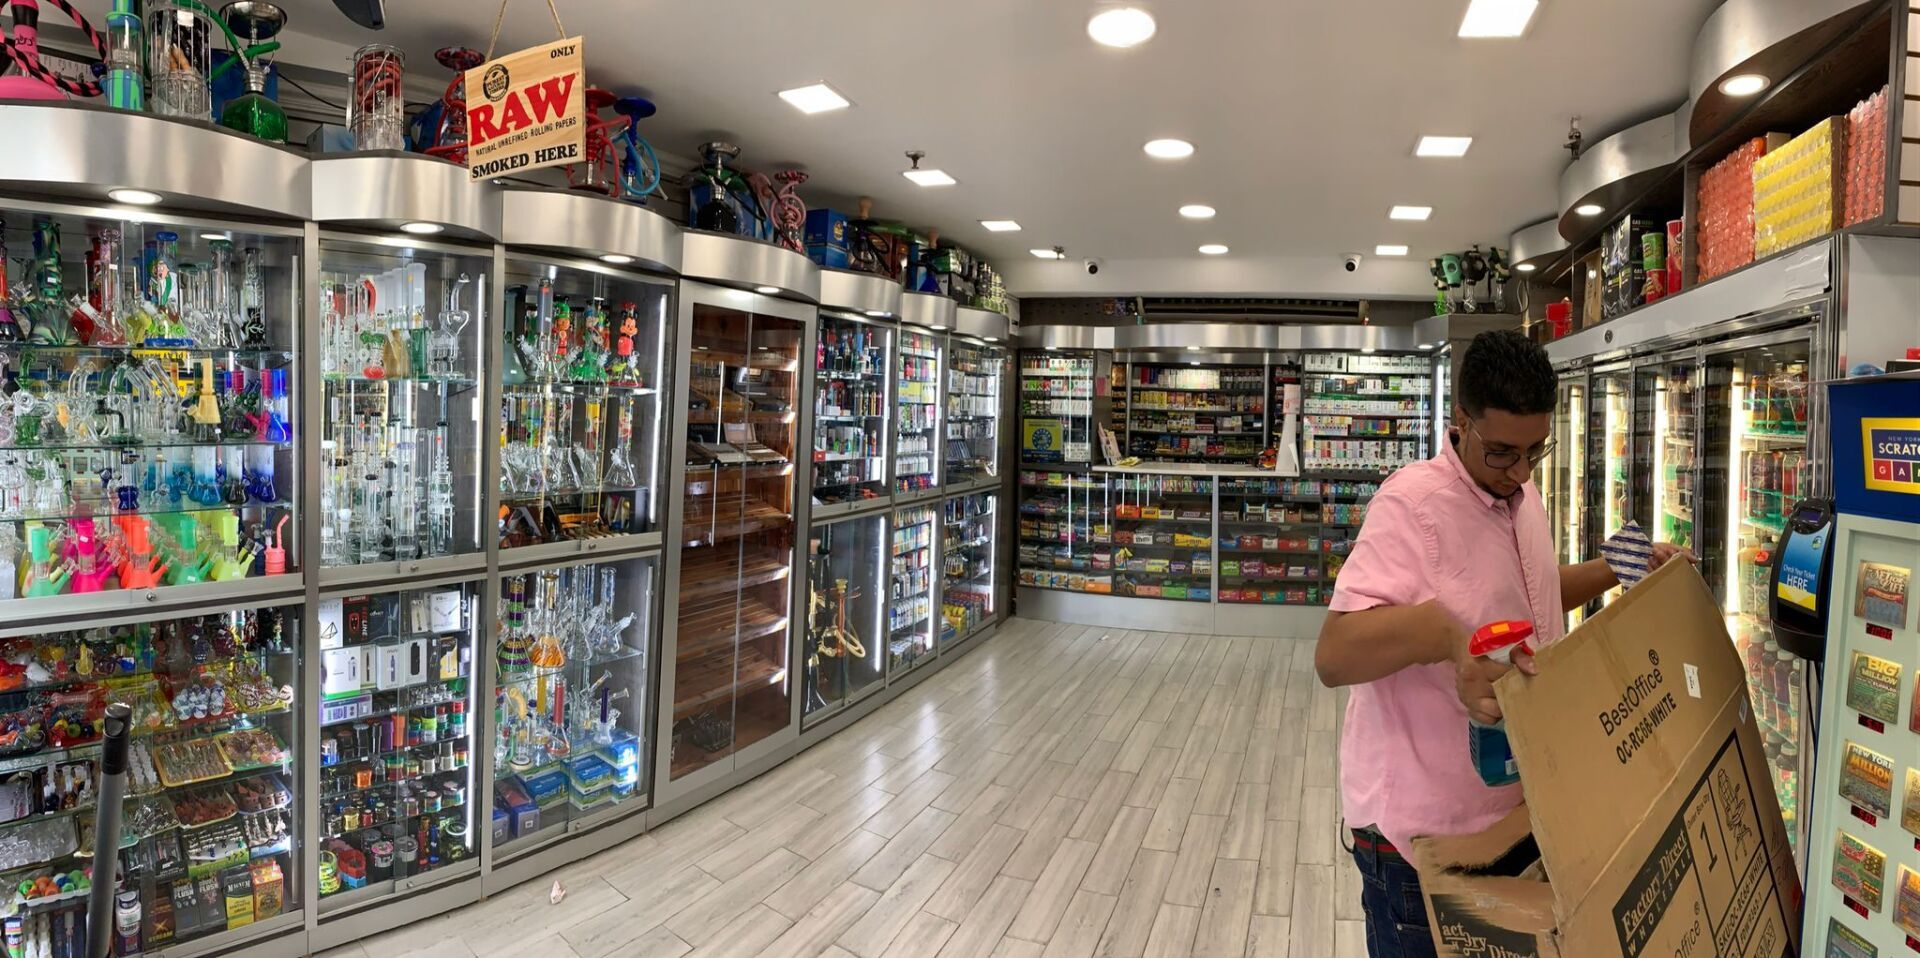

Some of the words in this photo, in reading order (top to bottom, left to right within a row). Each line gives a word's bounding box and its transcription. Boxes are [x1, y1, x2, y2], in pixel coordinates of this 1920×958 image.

[550, 45, 576, 59] ONLY
[468, 73, 576, 147] RAW
[476, 143, 497, 156] NATURAL
[498, 132, 529, 150] UNREFINED
[530, 124, 553, 137] ROLLING
[555, 116, 577, 130] PAPERS
[472, 152, 530, 179] SMOKED
[535, 143, 578, 164] HERE
[1786, 574, 1809, 592] HERE
[1861, 669, 1898, 686] MILLION
[1868, 655, 1897, 676] BIG
[1599, 668, 1663, 736] BestOffice
[1616, 692, 1677, 765] OC-RC66-WHITE
[1851, 757, 1890, 781] MILLION
[1852, 744, 1871, 758] NEW
[1700, 822, 1717, 872] 1
[1622, 872, 1661, 942] Factory
[1659, 828, 1688, 877] Direct
